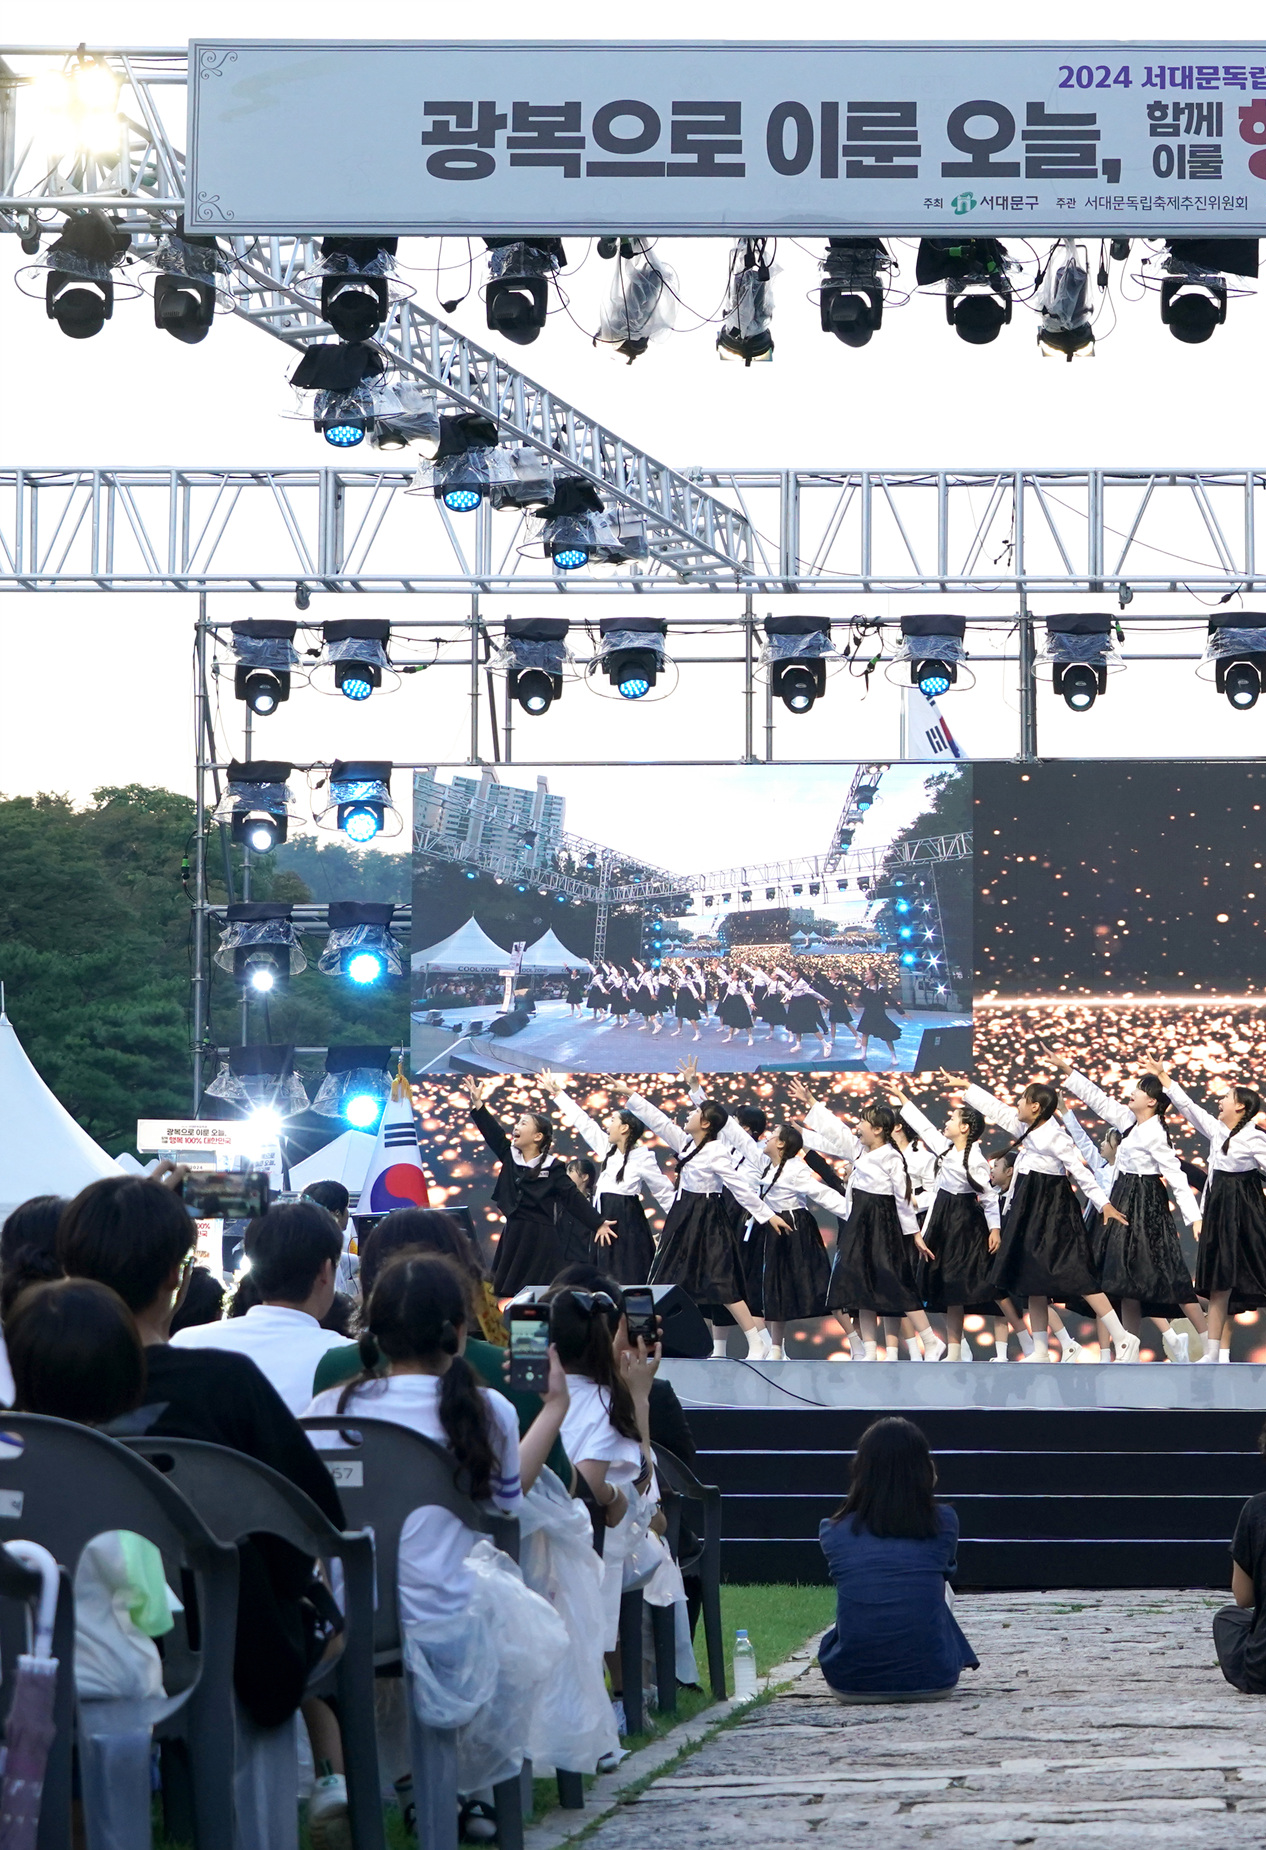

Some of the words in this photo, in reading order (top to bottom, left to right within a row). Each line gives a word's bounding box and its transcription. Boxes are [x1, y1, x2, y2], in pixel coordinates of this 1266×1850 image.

[1059, 65, 1132, 89] 2024
[1146, 100, 1223, 137] 함께
[421, 99, 746, 181] 광복으로
[766, 100, 922, 179] 이룬
[941, 99, 1122, 184] 오늘,
[1152, 143, 1224, 180] 이룰
[923, 197, 944, 210] 주최
[979, 195, 1040, 211] 서대문구
[1055, 197, 1077, 210] 주관
[1084, 195, 1248, 212] 서대문독립축제추진위원회
